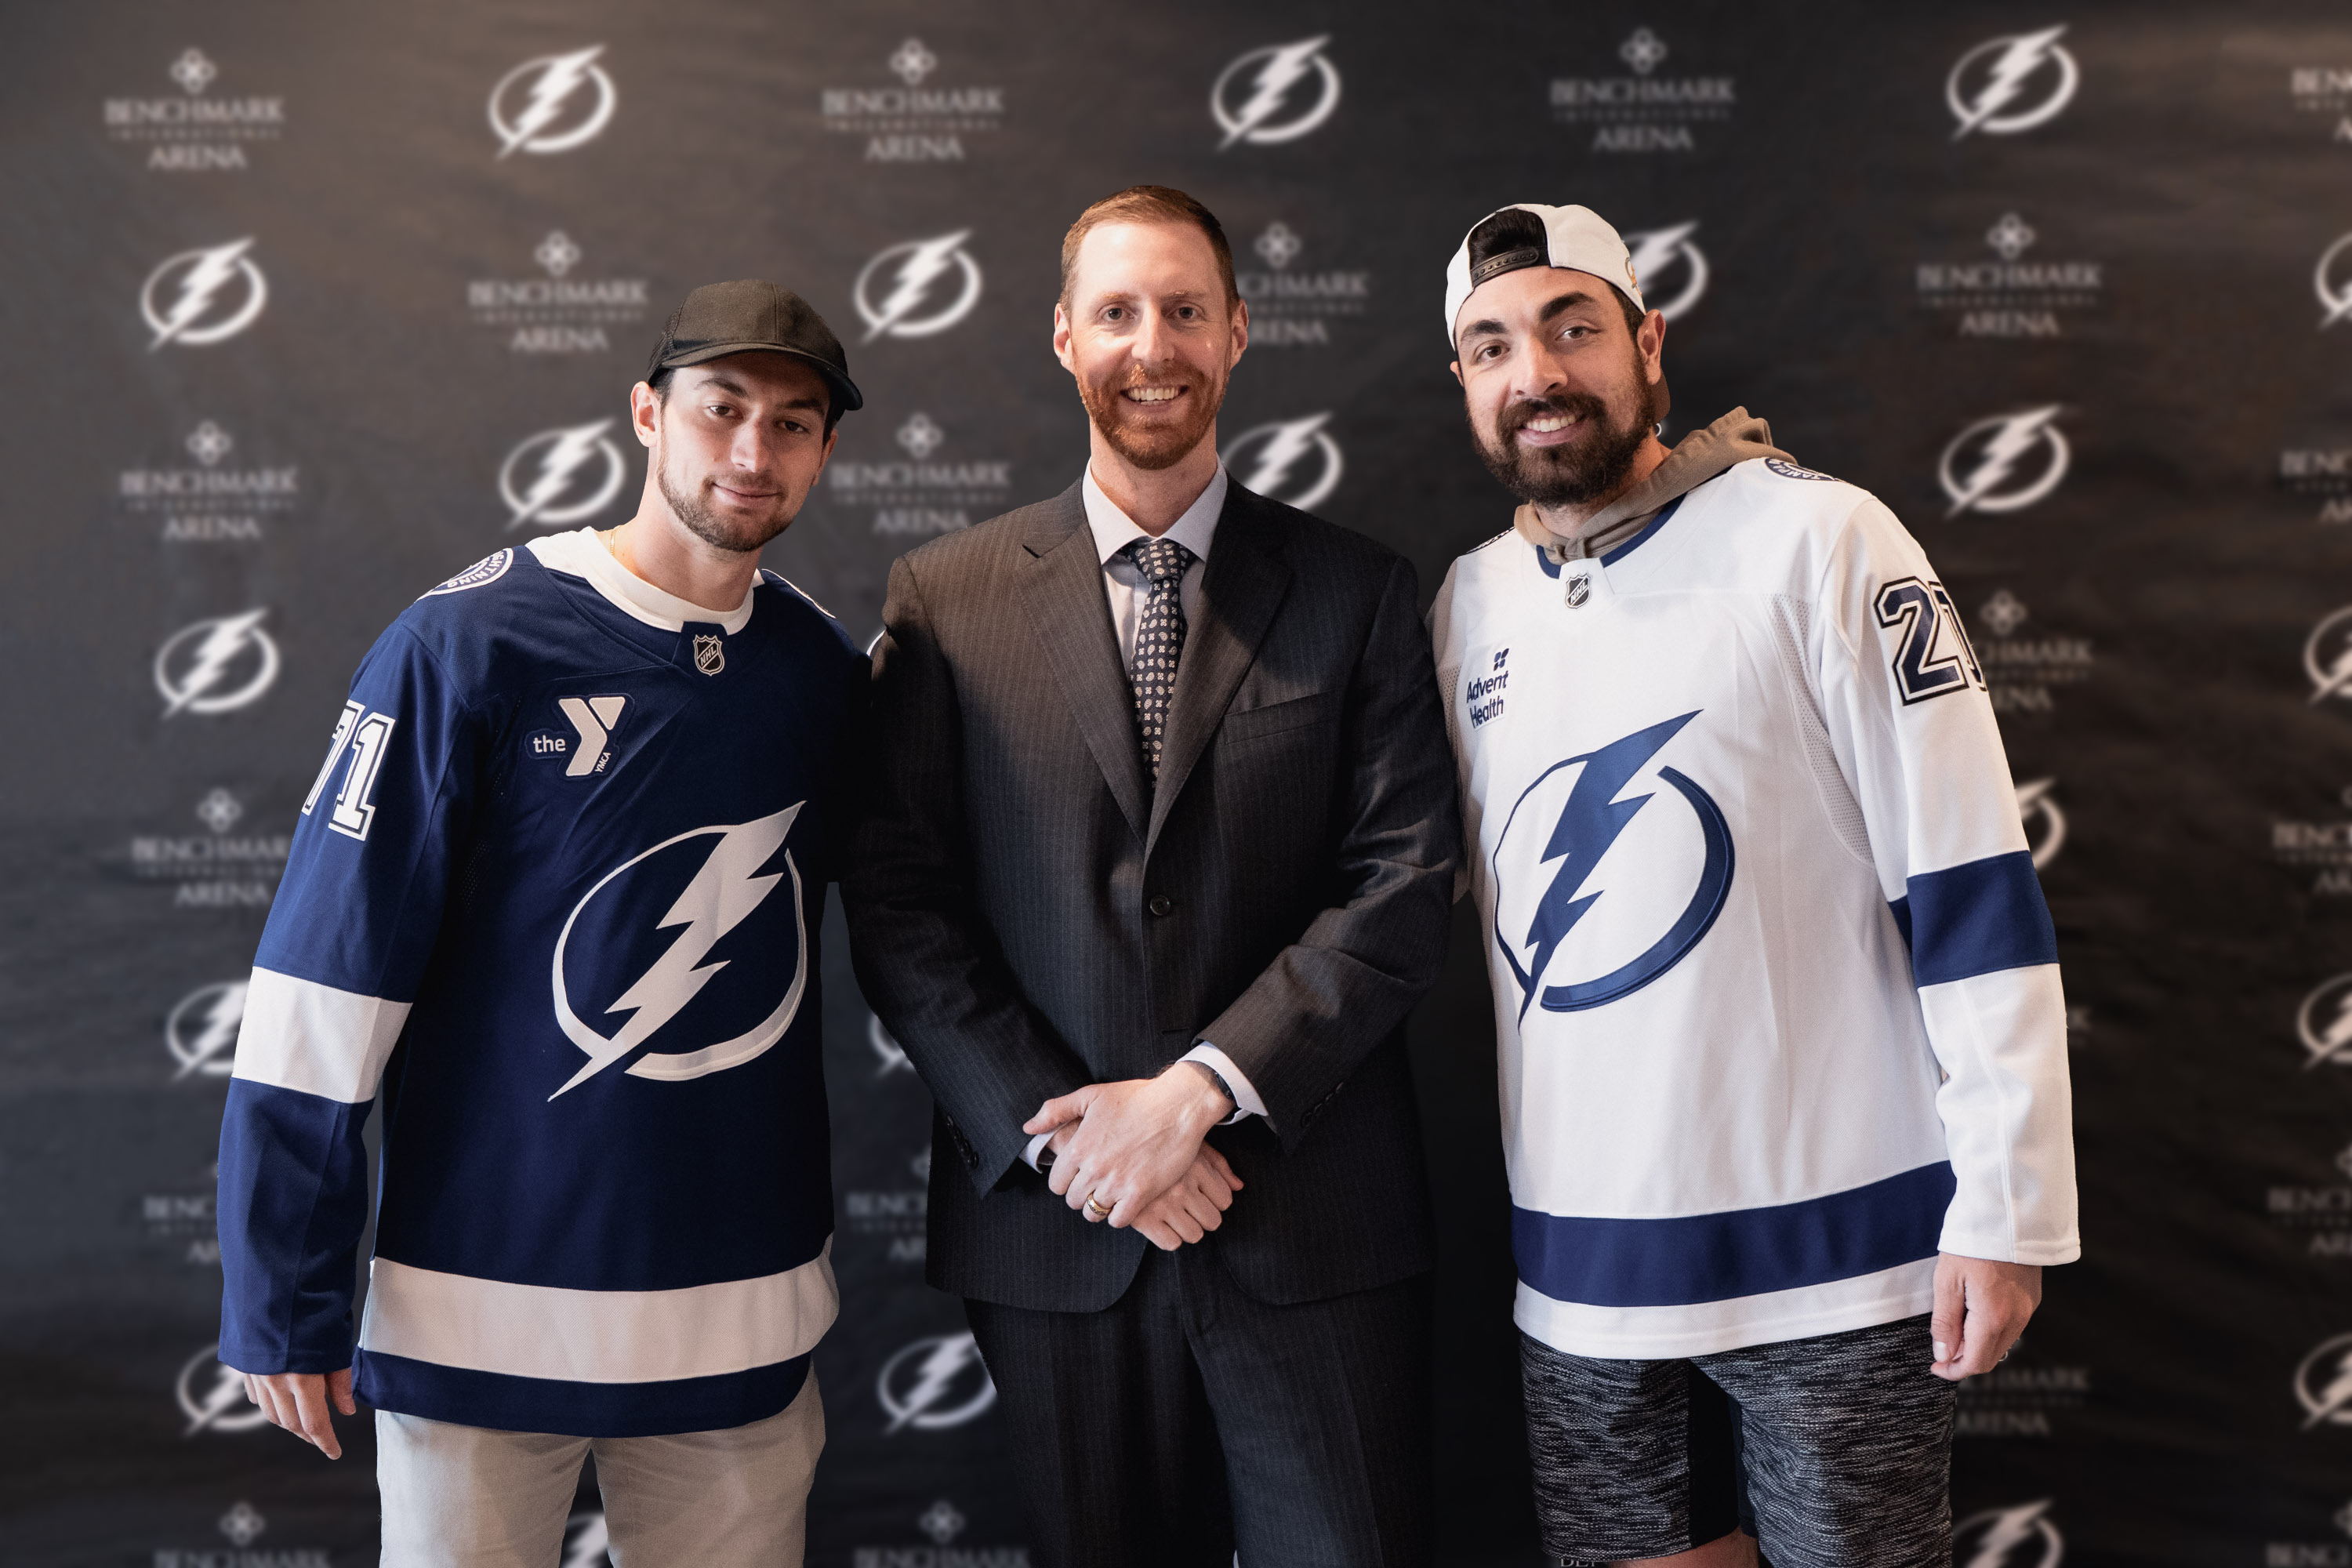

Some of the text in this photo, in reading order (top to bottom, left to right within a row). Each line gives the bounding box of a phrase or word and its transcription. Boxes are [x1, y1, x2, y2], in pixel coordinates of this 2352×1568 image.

[105, 97, 285, 124] BENCHMARK
[822, 89, 1004, 115] BENCHMARK
[865, 135, 967, 162] ARENA
[1594, 125, 1694, 152] ARENA
[147, 144, 247, 170] ARENA
[467, 280, 649, 307] BENCHMARK
[1960, 313, 2060, 338] ARENA
[511, 326, 610, 353] ARENA
[121, 468, 299, 496] BENCHMARK
[162, 514, 263, 542] ARENA
[1570, 580, 1588, 604] NHL
[699, 646, 717, 666] NHL
[1466, 670, 1509, 704] Advent
[1469, 695, 1504, 729] Health
[533, 735, 566, 753] the
[301, 699, 396, 842] 71
[594, 752, 612, 773] YMCA
[132, 835, 294, 862] BENCHMAR
[175, 880, 272, 907] ARENA
